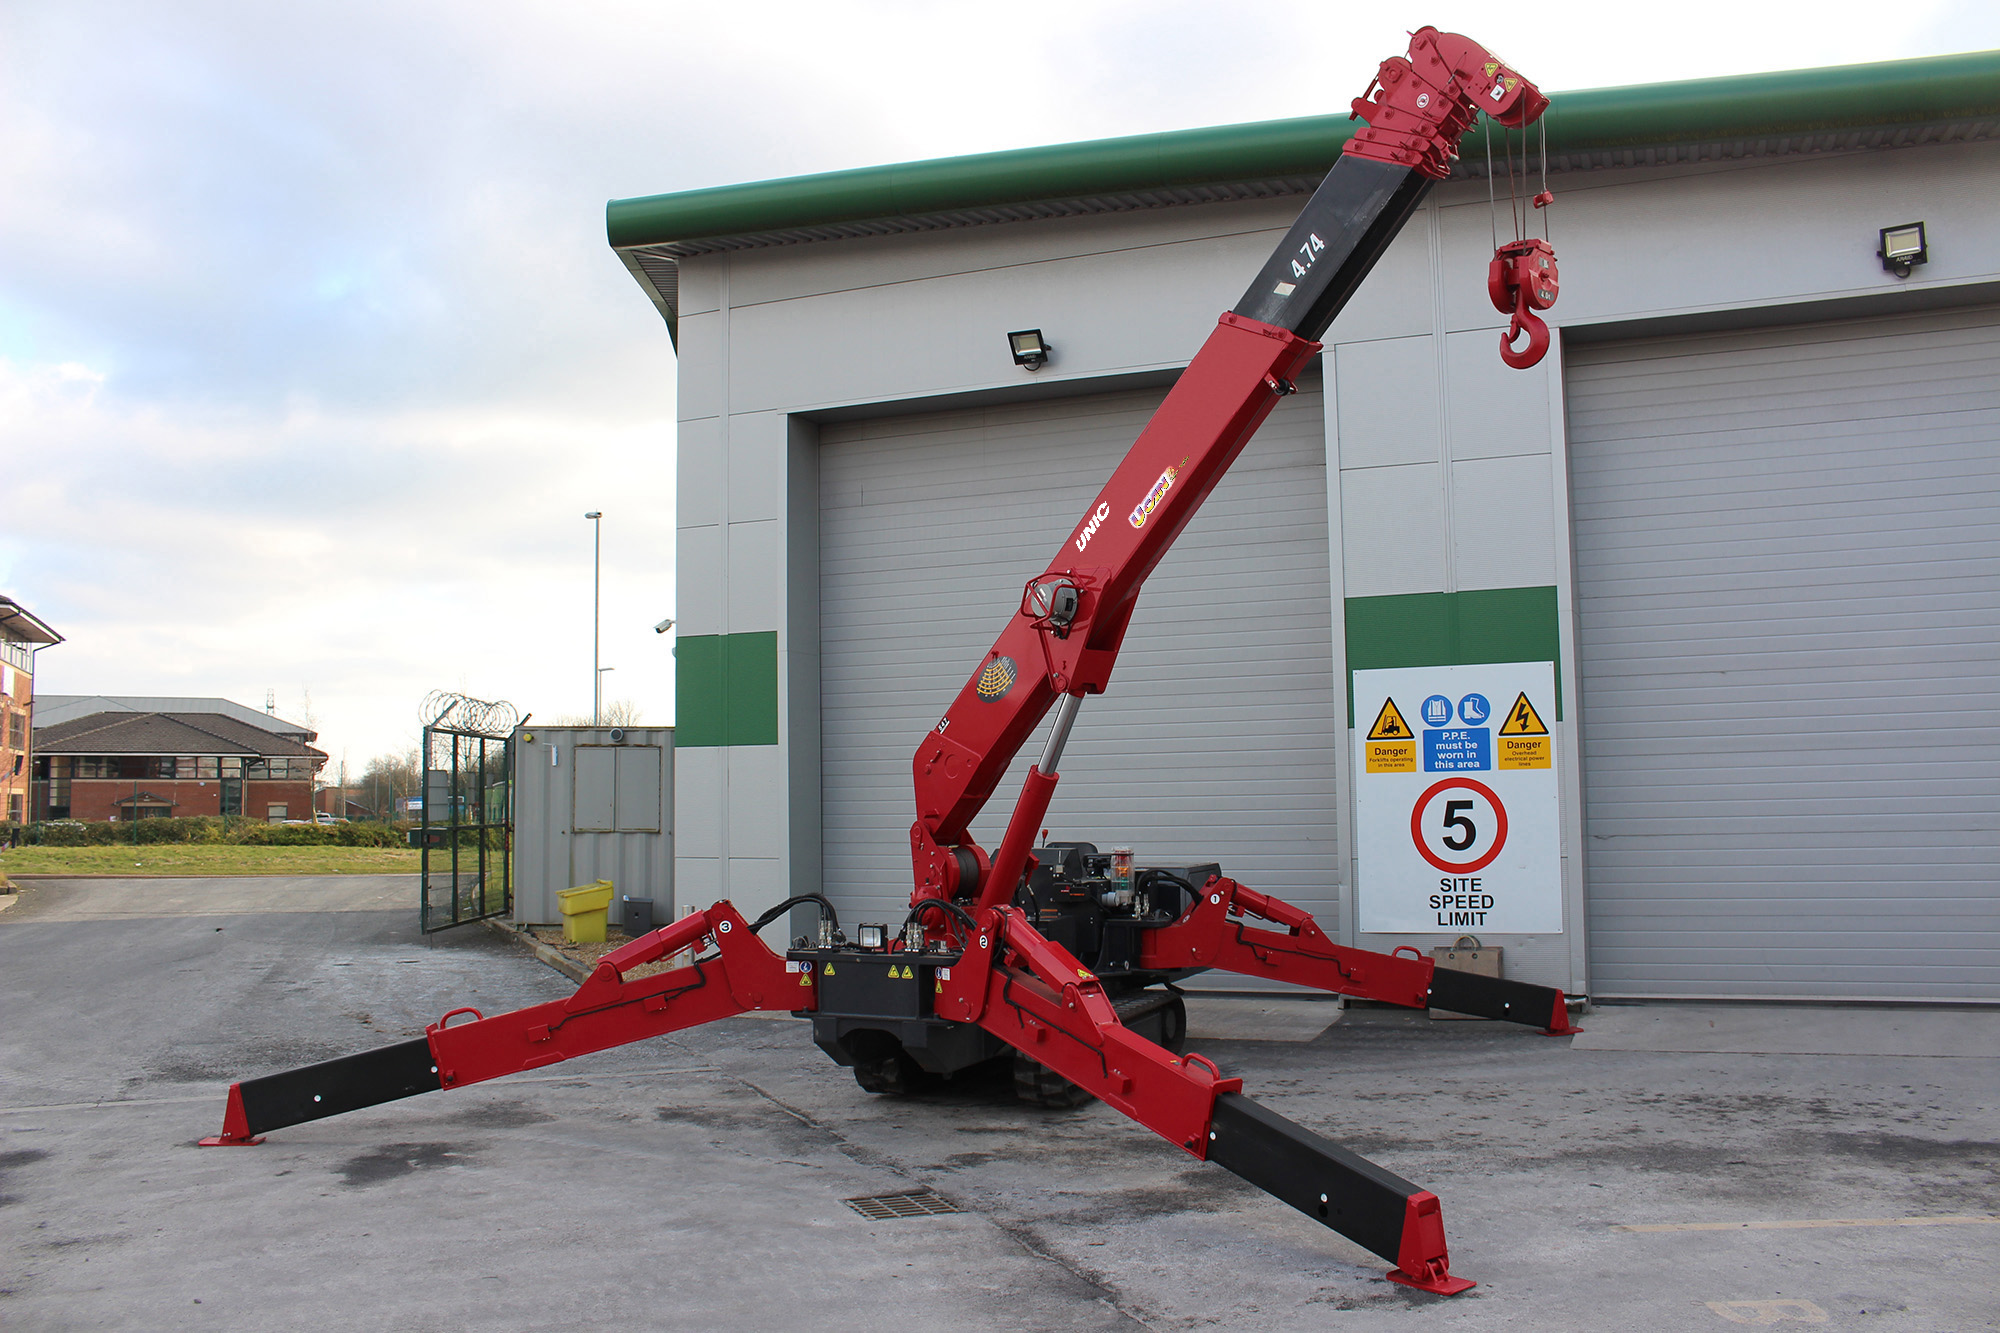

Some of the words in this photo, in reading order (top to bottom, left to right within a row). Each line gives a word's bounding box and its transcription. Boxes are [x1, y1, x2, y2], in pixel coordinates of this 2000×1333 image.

[1291, 232, 1325, 278] 4.74
[1076, 501, 1109, 552] UNIC
[1442, 731, 1471, 740] P.P.E.
[1436, 741, 1463, 750] must
[1465, 741, 1478, 749] be
[1507, 741, 1542, 750] Danger
[1374, 747, 1408, 757] Danger
[1466, 750, 1477, 759] in
[1435, 760, 1454, 769] this
[1442, 800, 1477, 851] 5
[1440, 877, 1483, 892] SITE
[1429, 894, 1495, 909] SPEED
[1437, 911, 1488, 926] LIMIT
